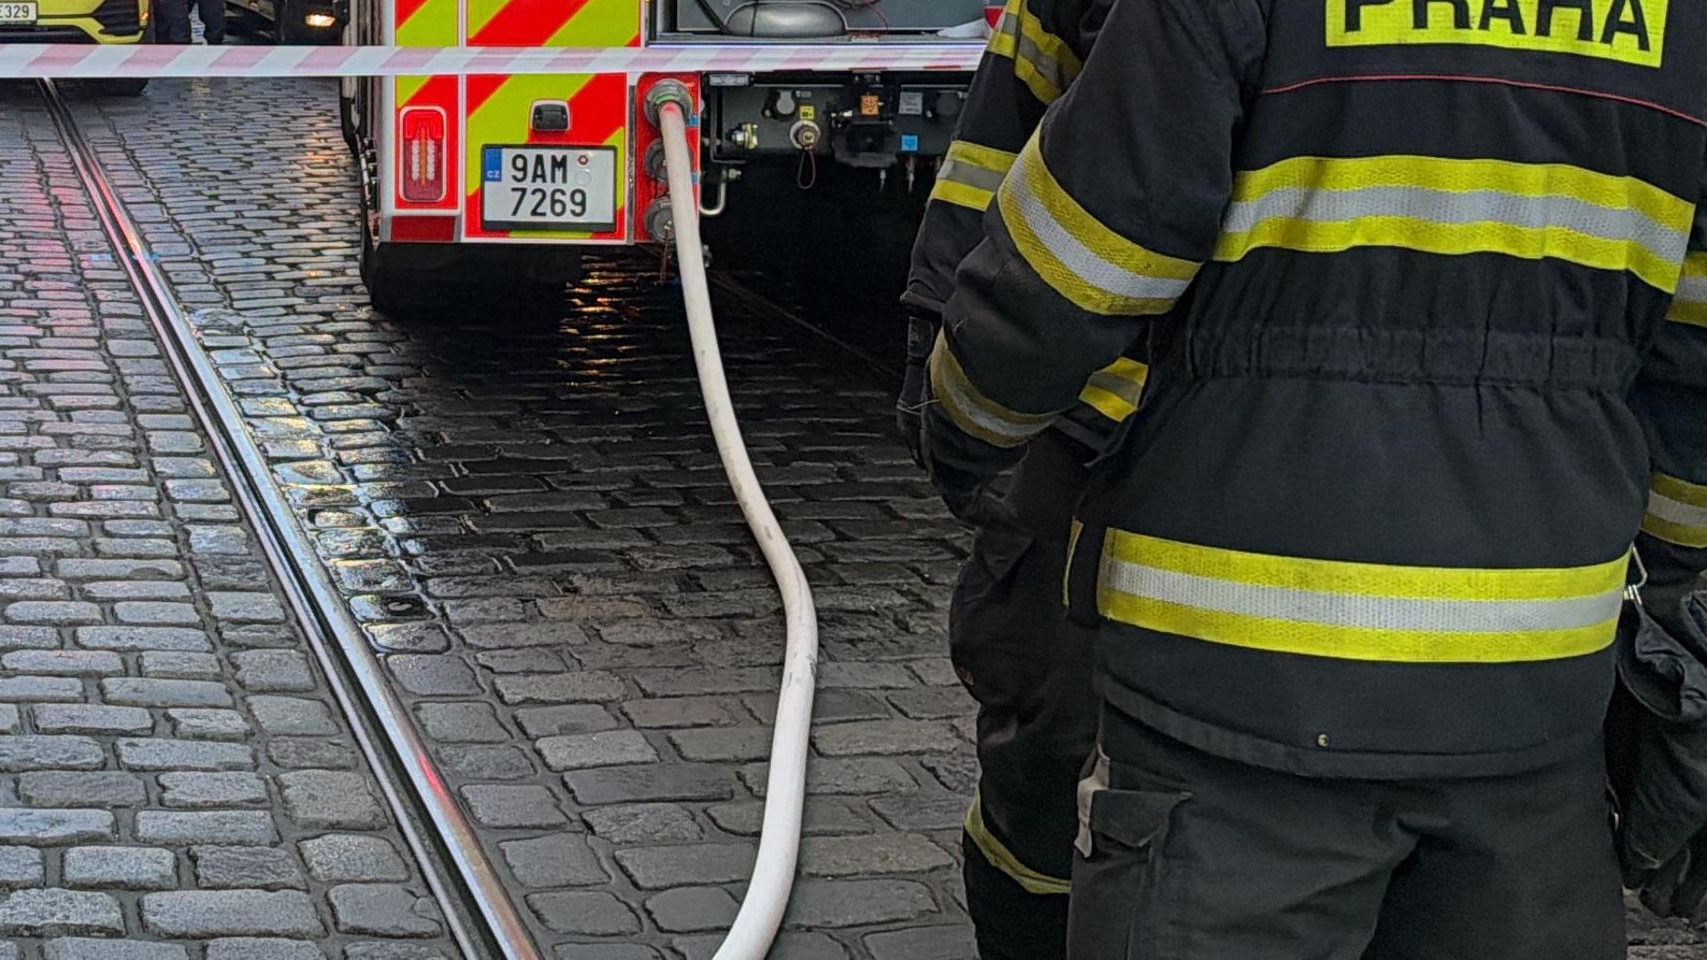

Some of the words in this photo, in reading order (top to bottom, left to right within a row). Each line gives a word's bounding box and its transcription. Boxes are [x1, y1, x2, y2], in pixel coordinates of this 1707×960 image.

[486, 169, 501, 179] CZ
[511, 153, 568, 184] 9AM
[511, 187, 587, 217] 7269
